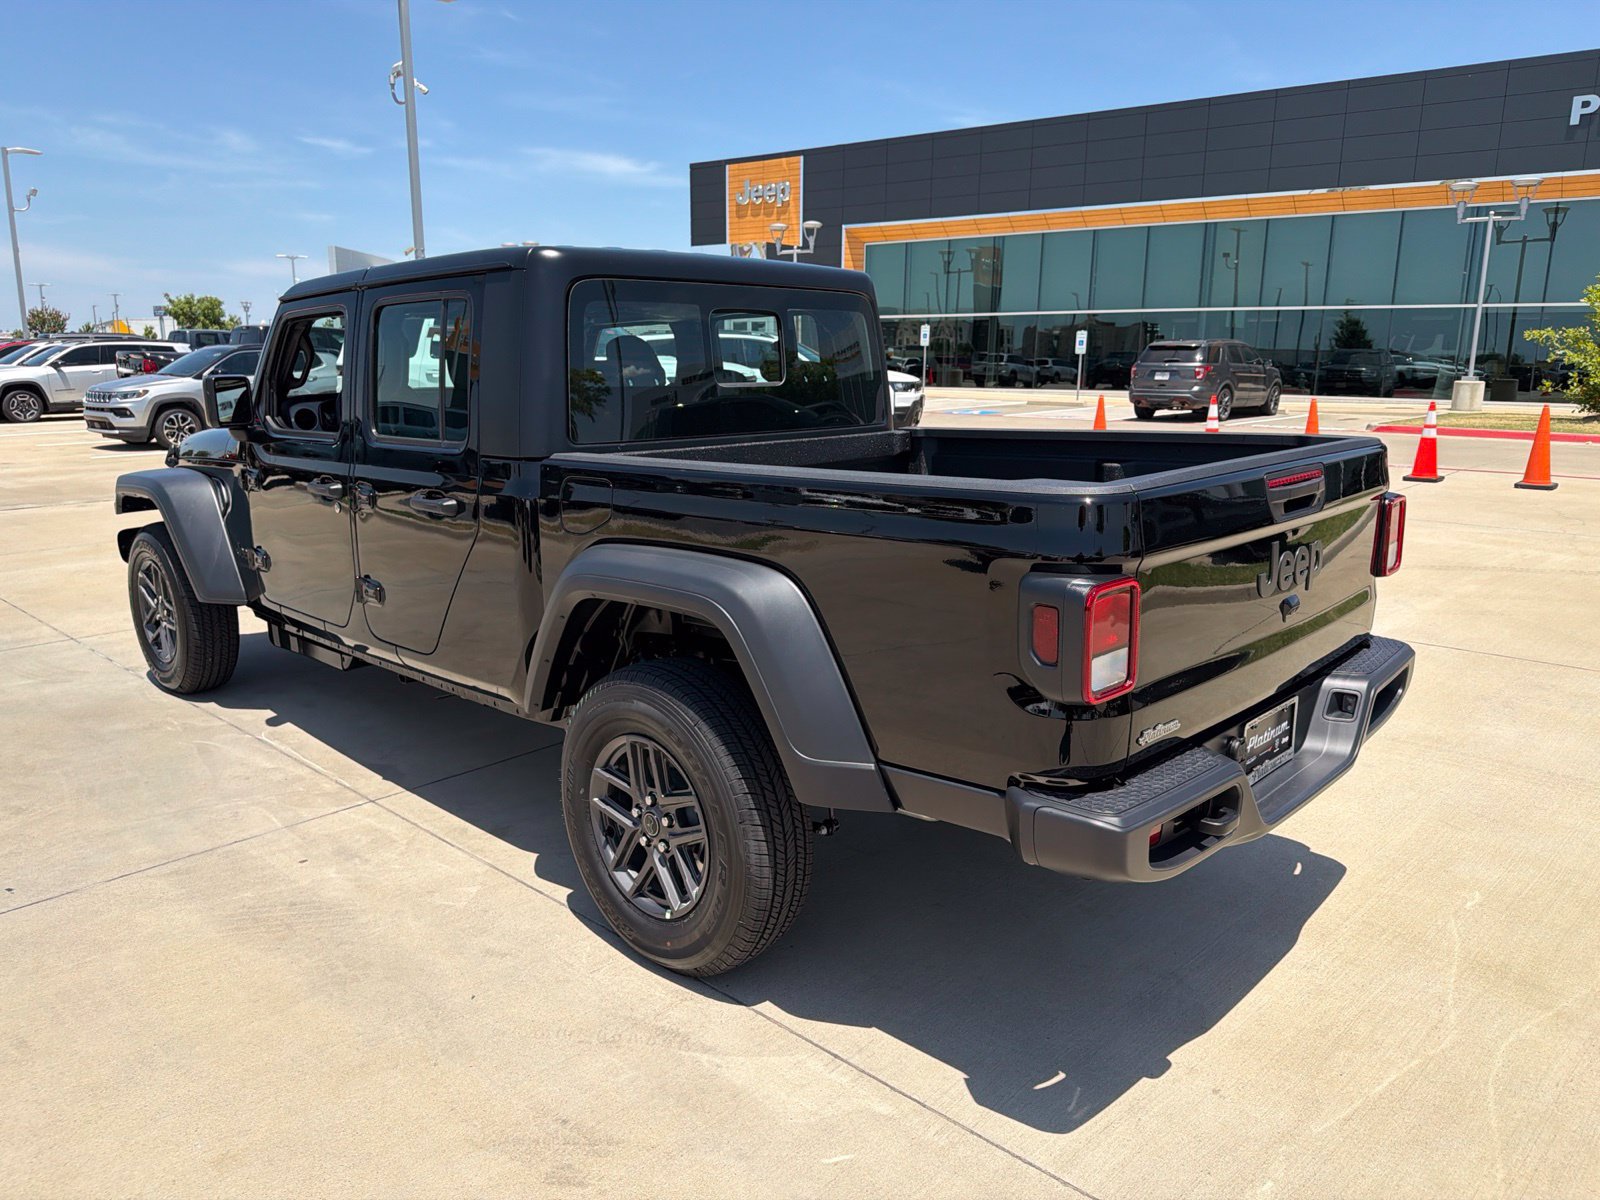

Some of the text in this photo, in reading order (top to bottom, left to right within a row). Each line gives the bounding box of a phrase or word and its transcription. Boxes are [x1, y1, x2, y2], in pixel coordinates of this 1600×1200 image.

[736, 178, 790, 207] Jeep
[1257, 540, 1323, 598] Jeep
[1247, 720, 1290, 753] Platinum
